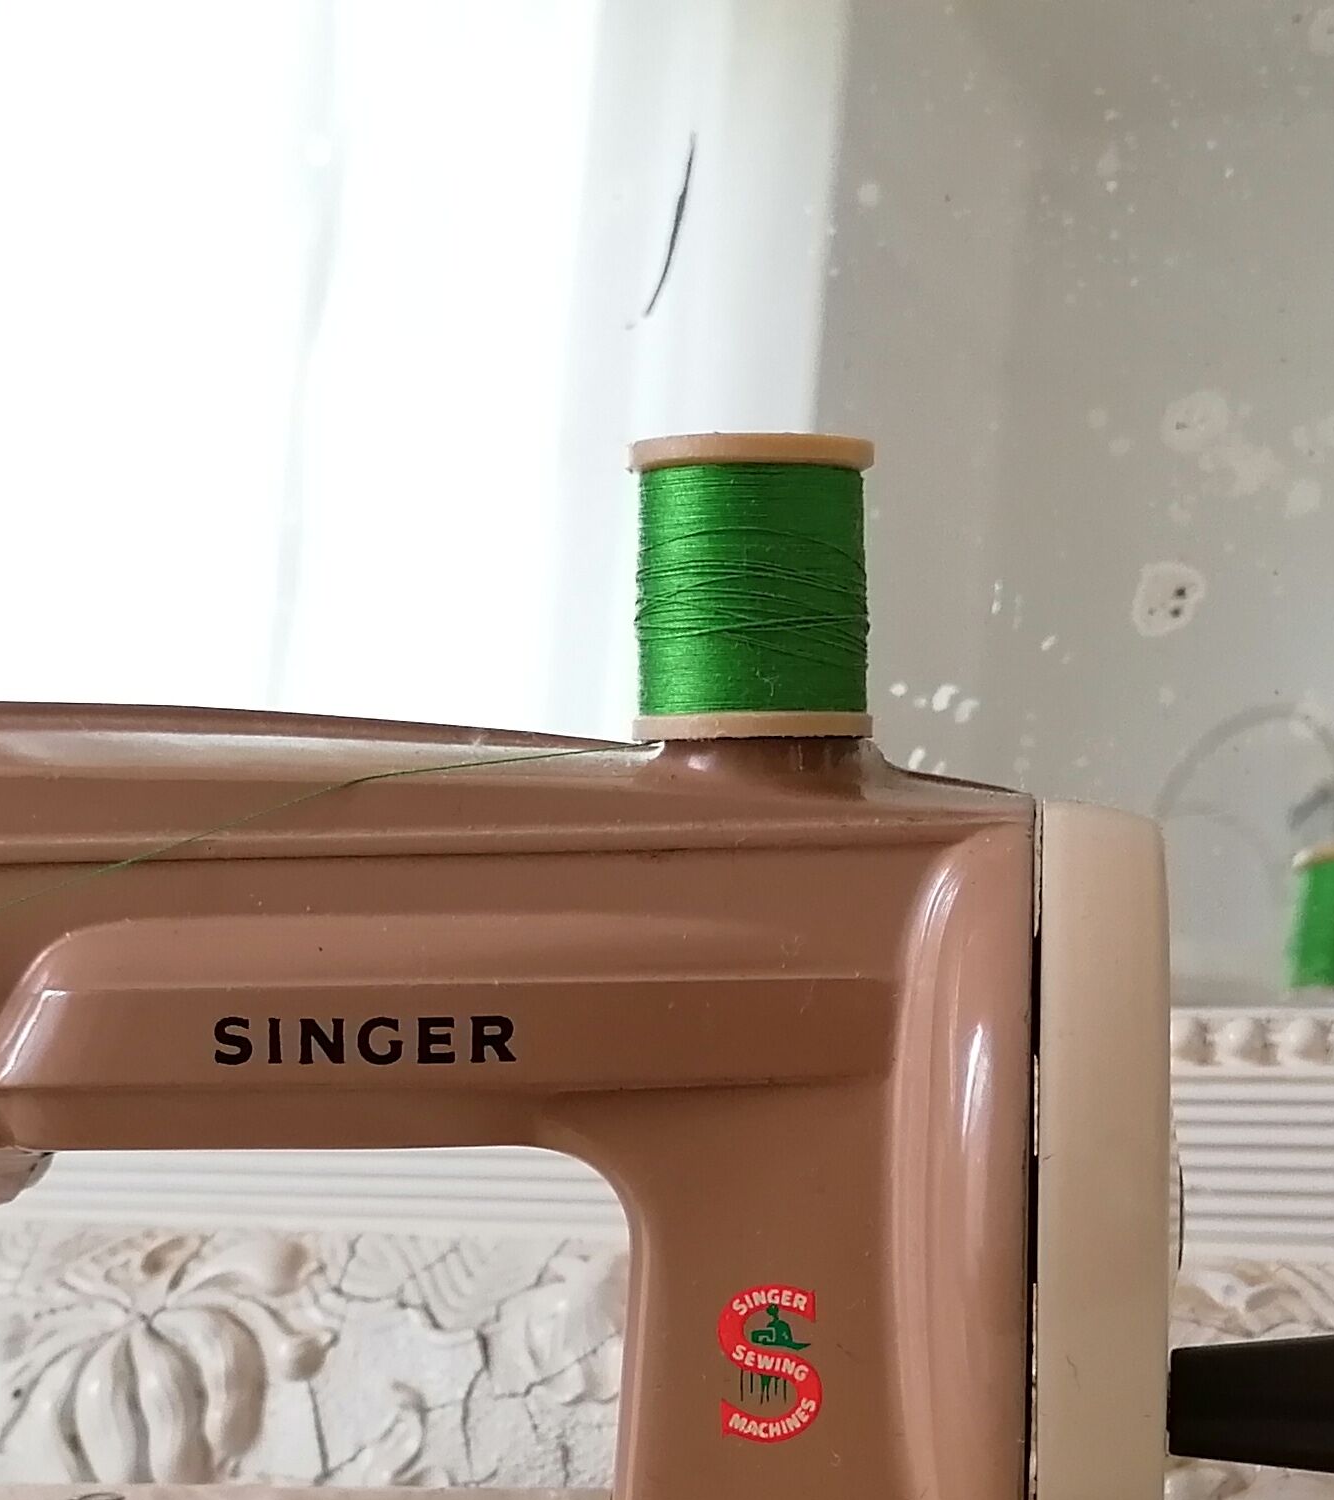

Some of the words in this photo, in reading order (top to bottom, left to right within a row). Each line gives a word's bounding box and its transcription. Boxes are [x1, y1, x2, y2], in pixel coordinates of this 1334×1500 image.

[214, 1016, 517, 1065] SINGER
[731, 1288, 808, 1316] SINGER
[731, 1344, 809, 1382] SEWING
[728, 1397, 816, 1438] MACHINES
